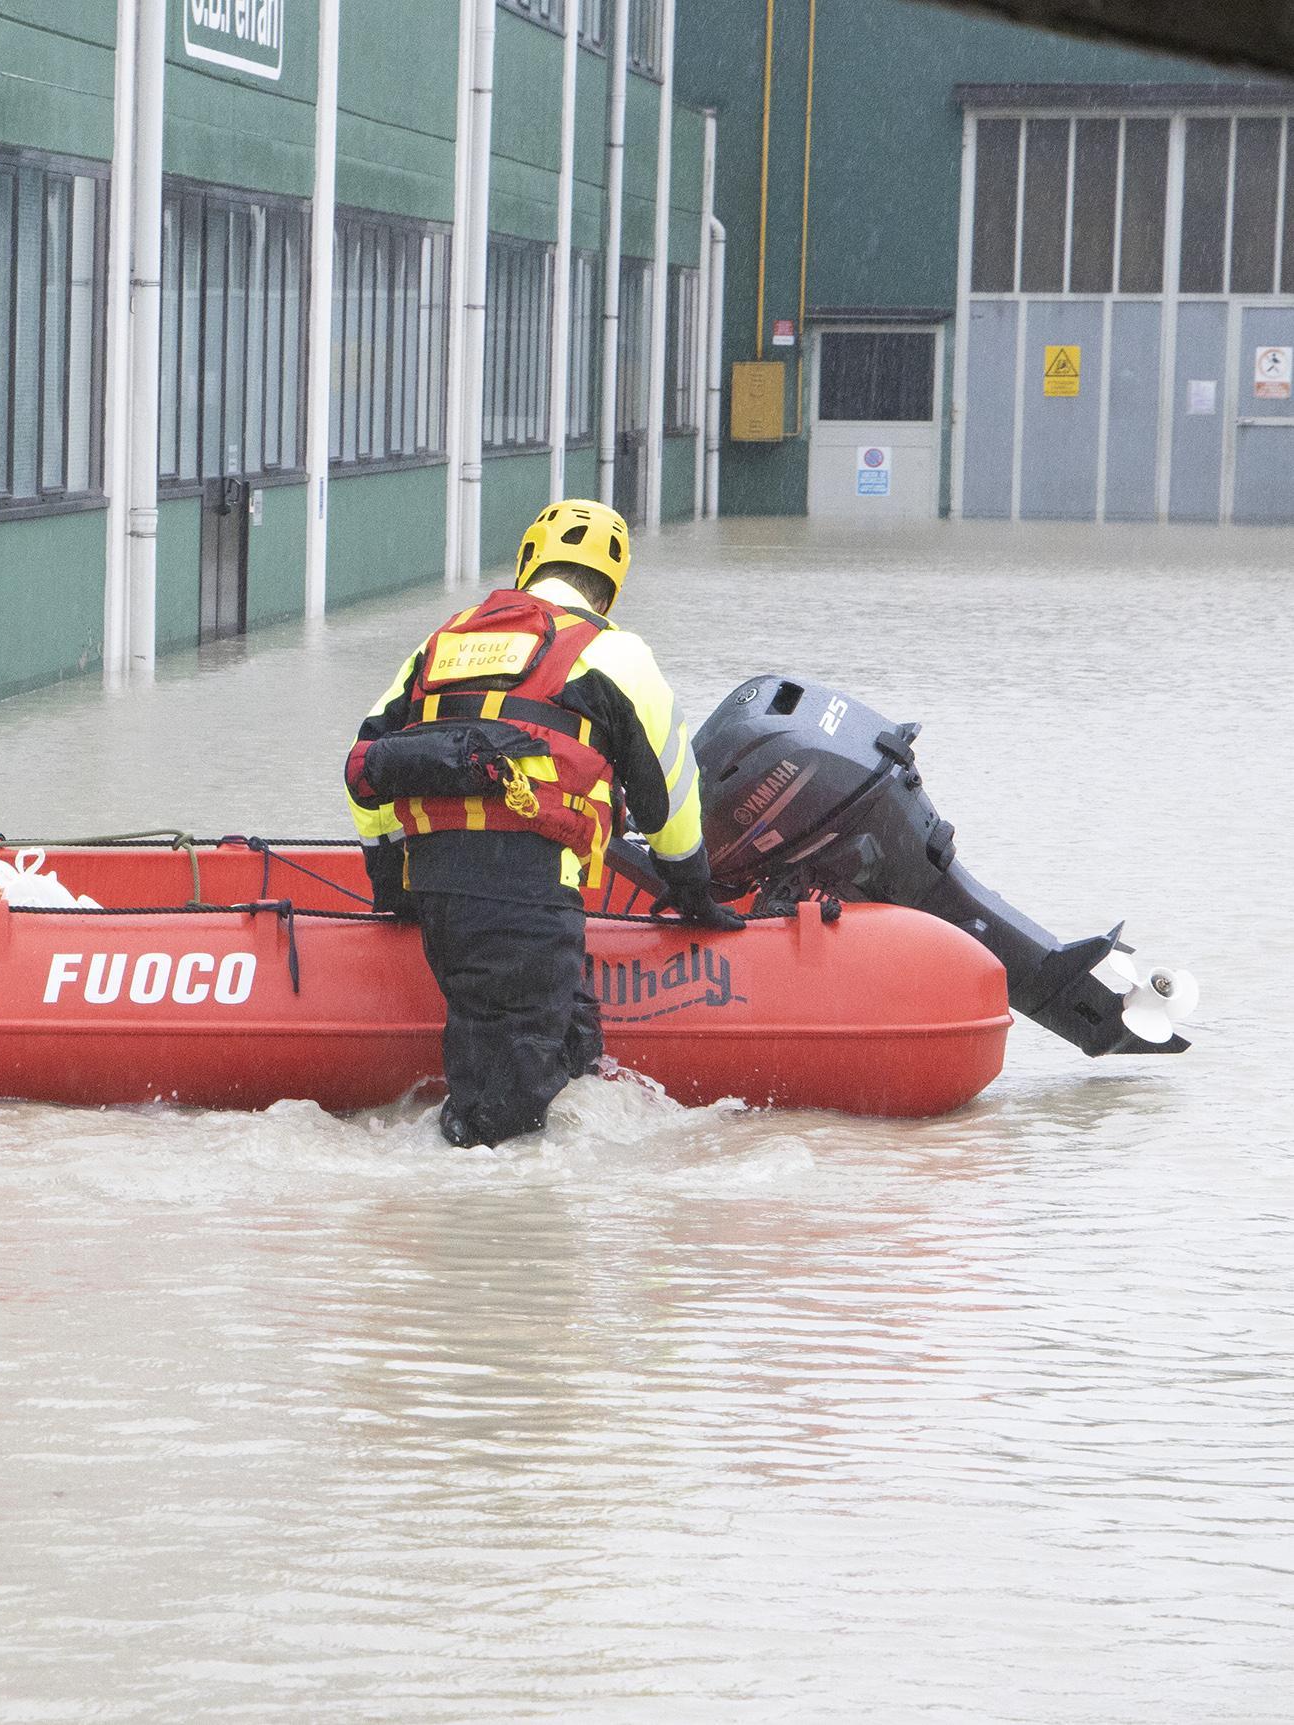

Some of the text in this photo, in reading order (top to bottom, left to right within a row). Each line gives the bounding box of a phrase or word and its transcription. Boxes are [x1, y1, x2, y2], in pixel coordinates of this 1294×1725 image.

[438, 655, 518, 669] DEL FUOCO
[459, 642, 509, 653] VIGILI
[818, 695, 848, 737] 25
[747, 759, 799, 814] YAMAHA
[42, 952, 258, 1005] FUOCO
